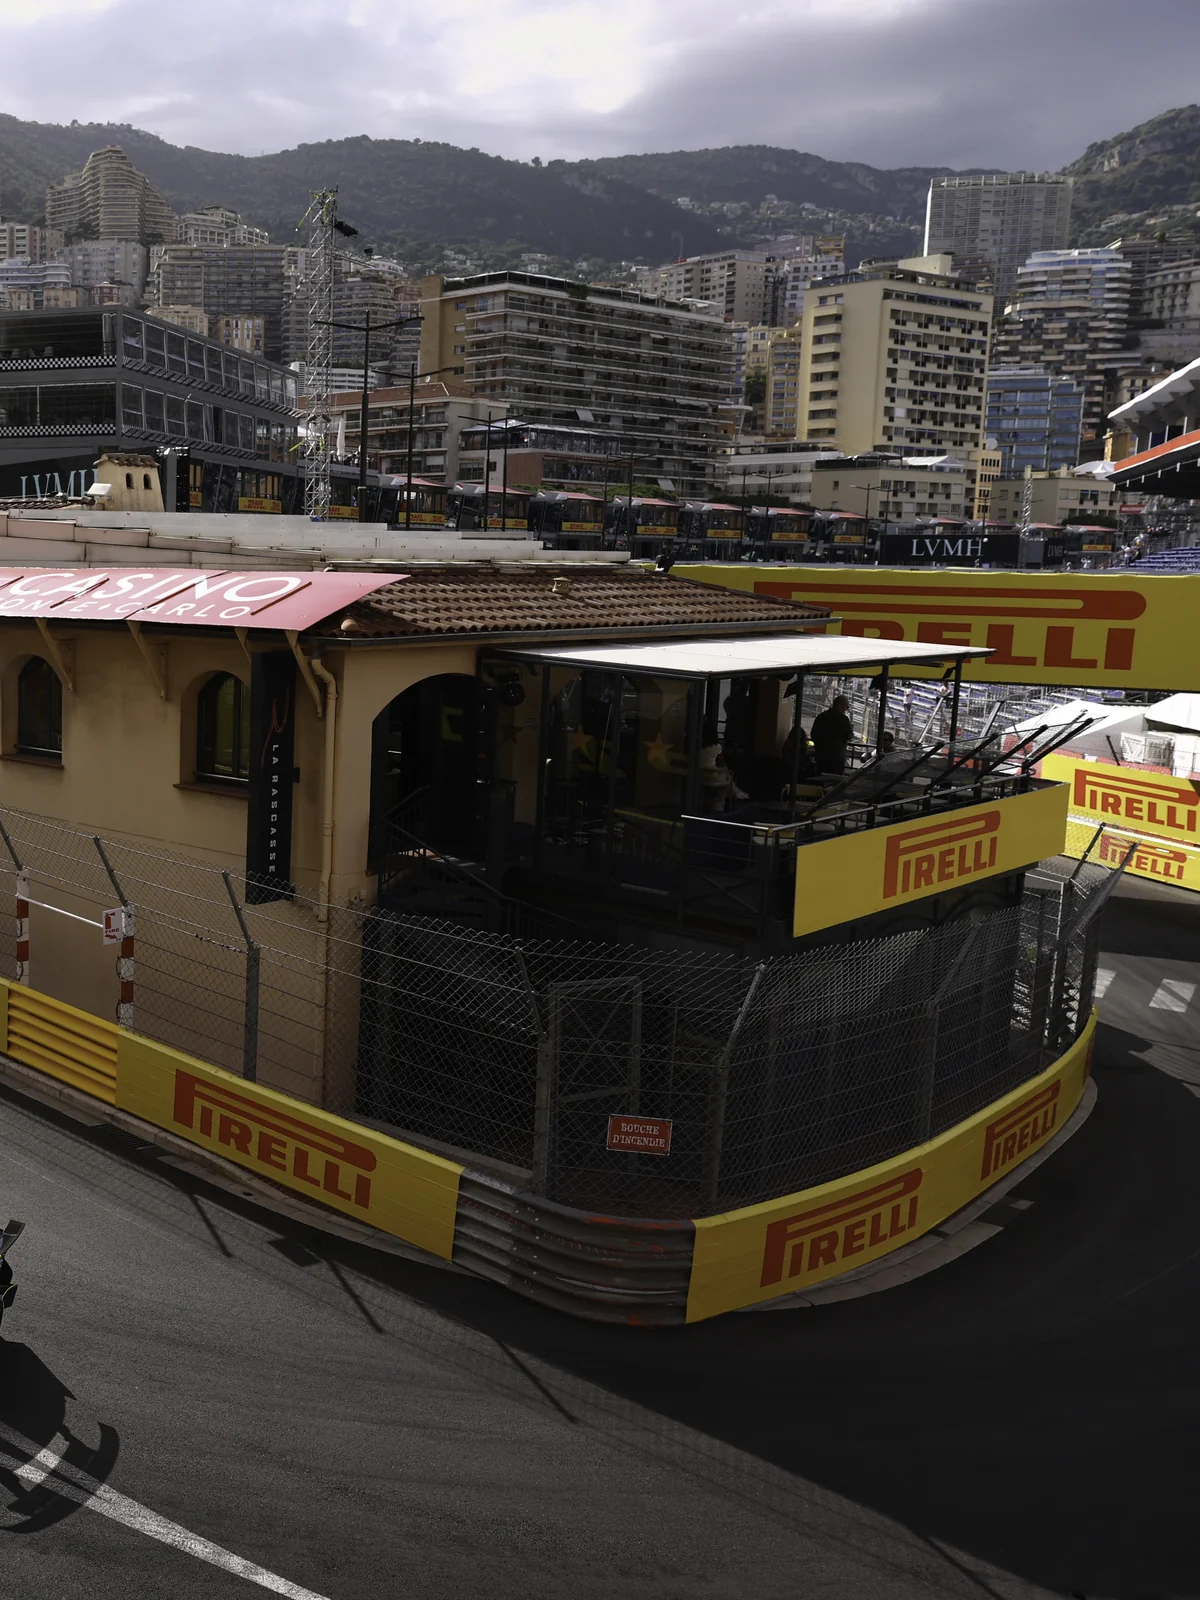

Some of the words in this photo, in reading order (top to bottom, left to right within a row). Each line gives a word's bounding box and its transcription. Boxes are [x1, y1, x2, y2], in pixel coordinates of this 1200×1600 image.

[911, 538, 984, 557] LVMH
[9, 572, 302, 602] CASINO
[114, 601, 251, 619] CARLO
[753, 581, 1147, 671] PELLI
[272, 744, 279, 764] LA
[269, 775, 279, 873] RASCASSE
[1074, 768, 1200, 832] PIRELLI
[883, 809, 1001, 899] PIRELLI
[172, 1068, 378, 1210] PIRELLI
[612, 1134, 666, 1148] D'INCENDIE
[621, 1123, 660, 1135] BOUCHE
[980, 1079, 1061, 1181] PIRELLI
[760, 1168, 923, 1288] PIRELLI
